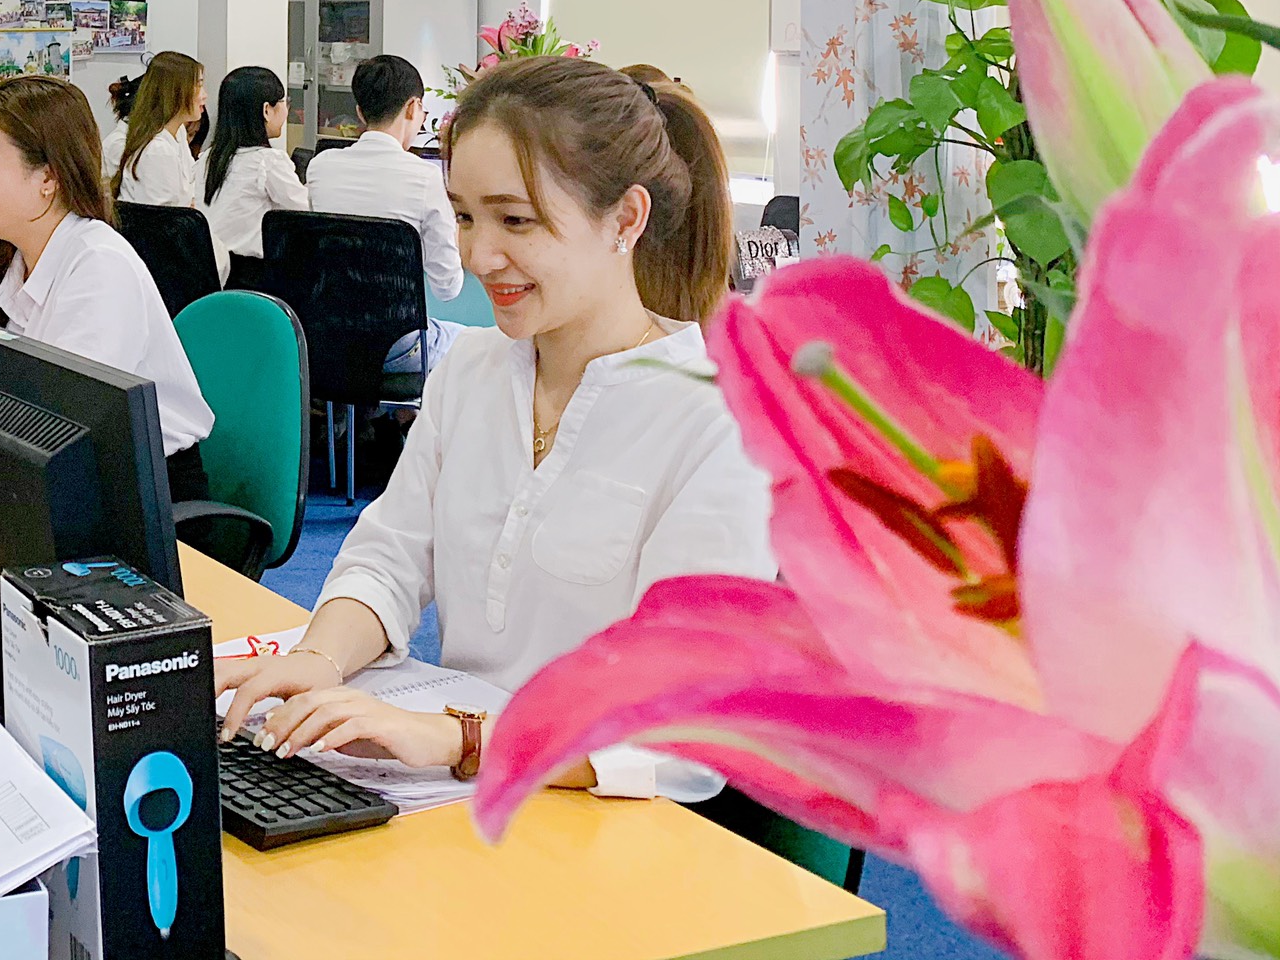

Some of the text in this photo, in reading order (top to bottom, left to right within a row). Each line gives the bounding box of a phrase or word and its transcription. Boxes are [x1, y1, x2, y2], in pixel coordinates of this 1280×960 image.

[747, 240, 779, 258] Dior
[105, 651, 199, 682] Panasonic
[106, 691, 147, 705] Hair Dryer
[107, 701, 156, 718] Máy Sấy Tóc
